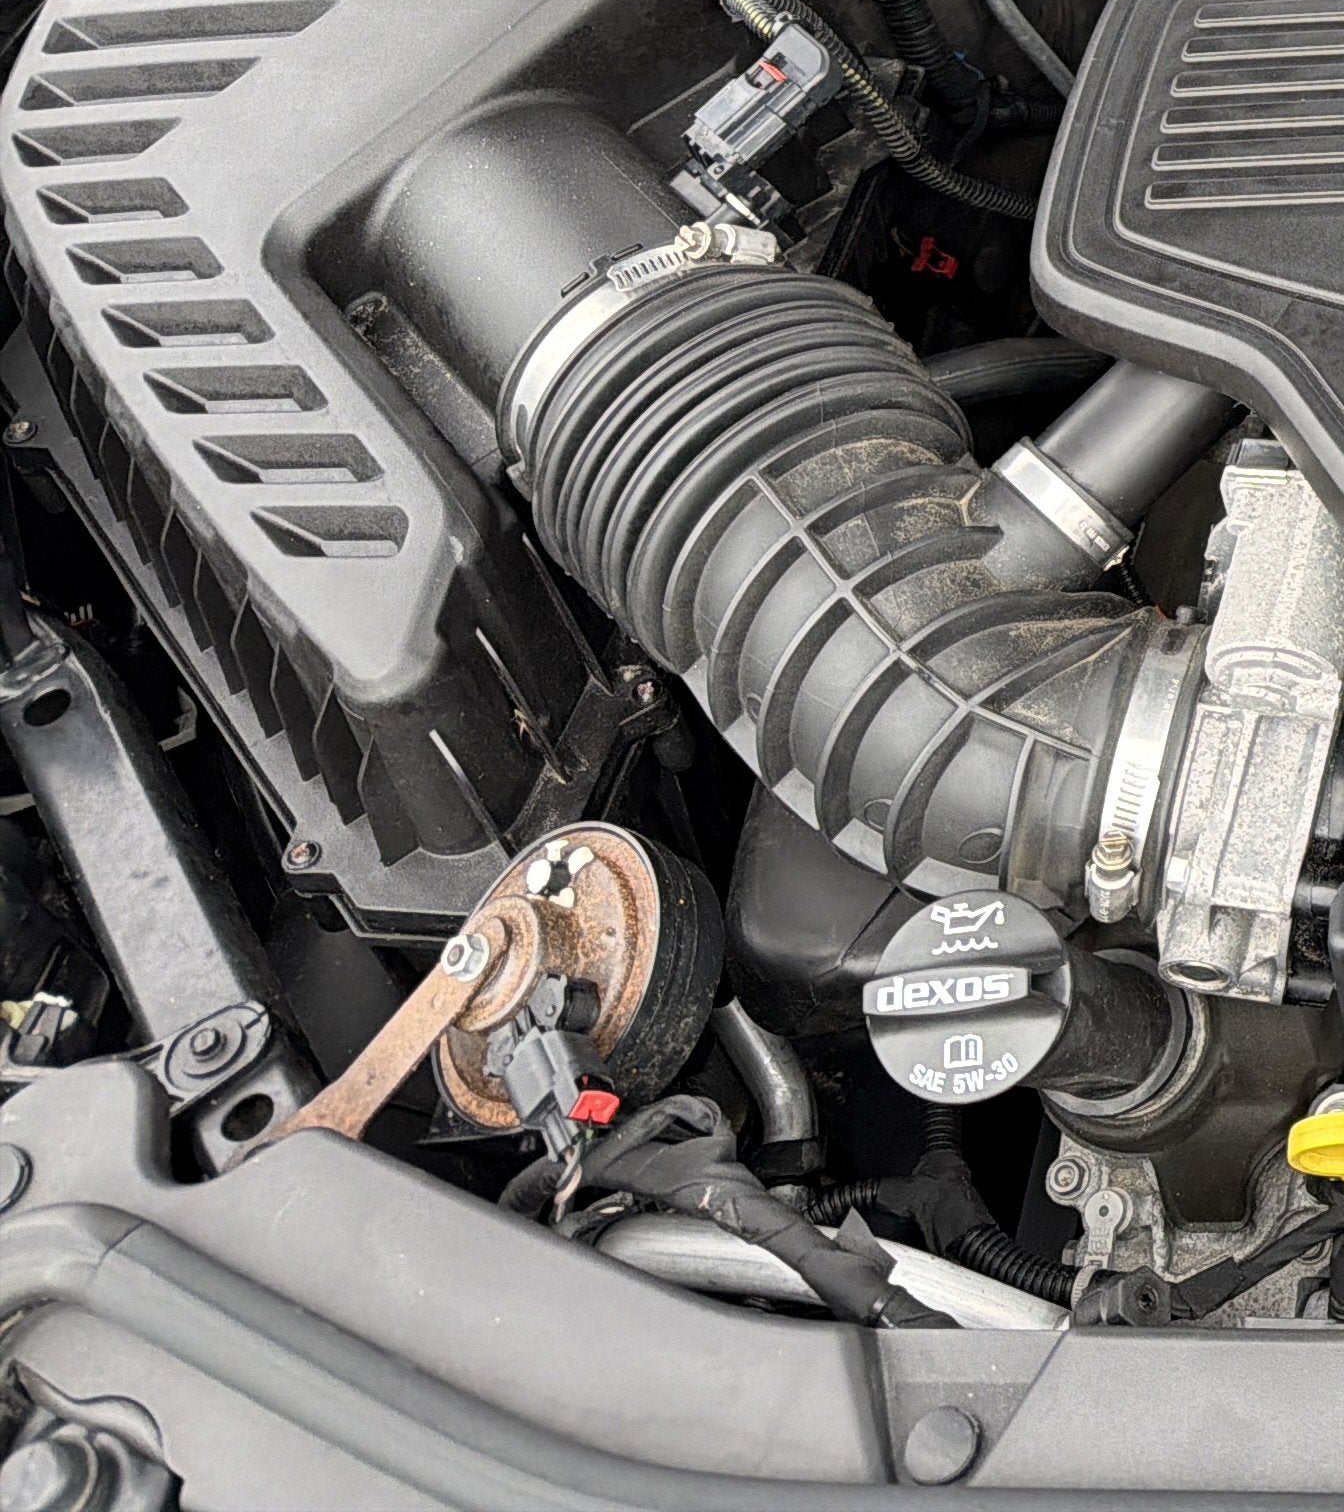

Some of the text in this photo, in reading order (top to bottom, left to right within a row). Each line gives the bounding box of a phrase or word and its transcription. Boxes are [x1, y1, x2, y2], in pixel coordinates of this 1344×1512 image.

[876, 975, 1011, 1013] dexos
[909, 1051, 1020, 1095] SAE 5W-30
